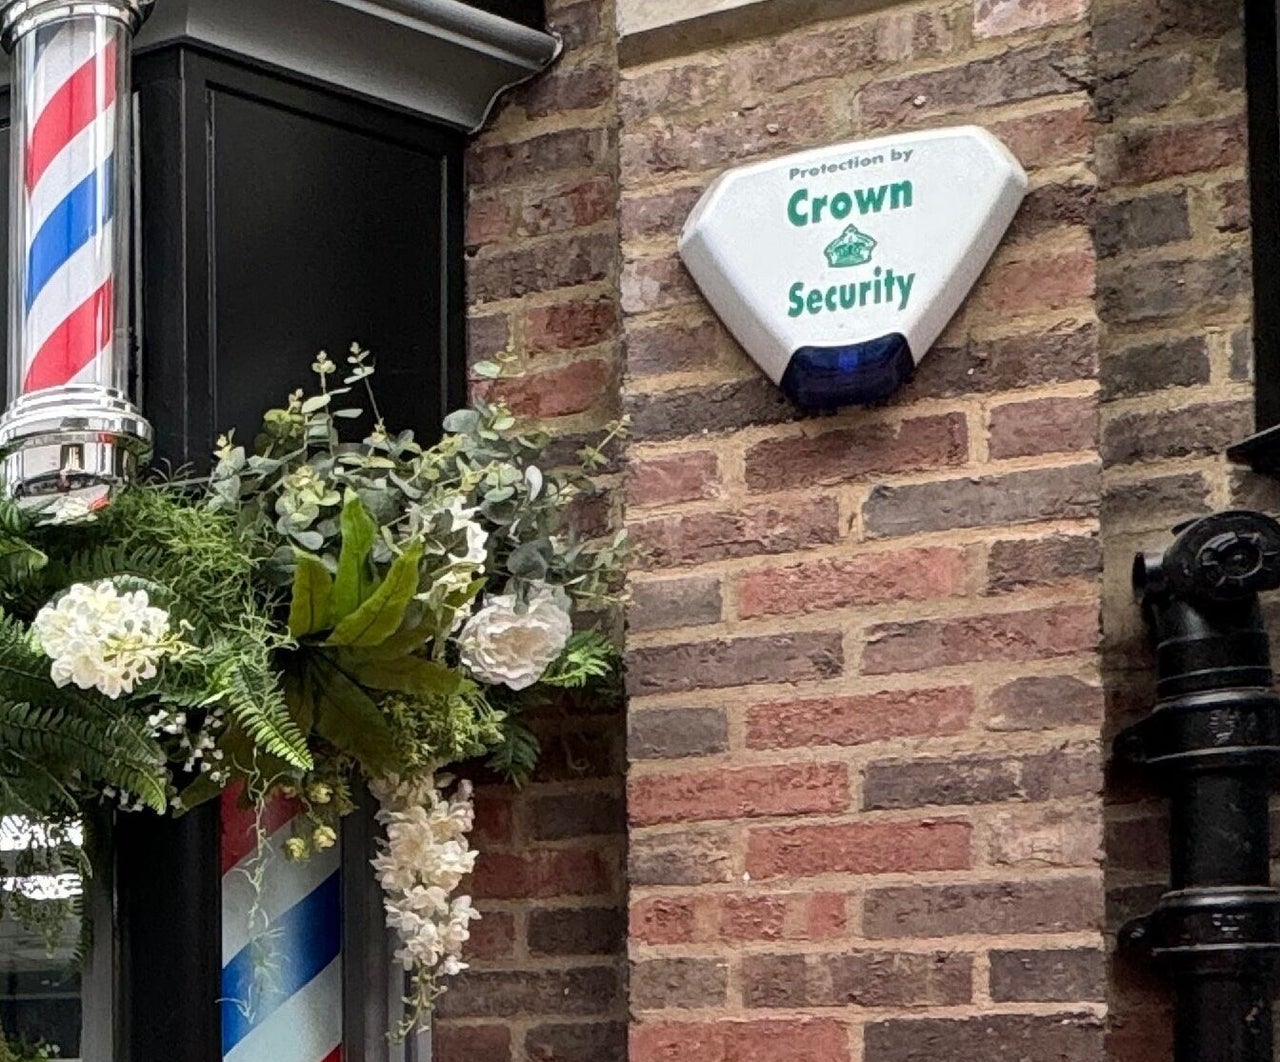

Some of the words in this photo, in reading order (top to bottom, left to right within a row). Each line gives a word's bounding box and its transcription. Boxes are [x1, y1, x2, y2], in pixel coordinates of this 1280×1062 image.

[789, 155, 884, 180] Protection
[890, 149, 914, 163] by
[787, 180, 913, 227] Crown
[787, 266, 916, 318] Security
